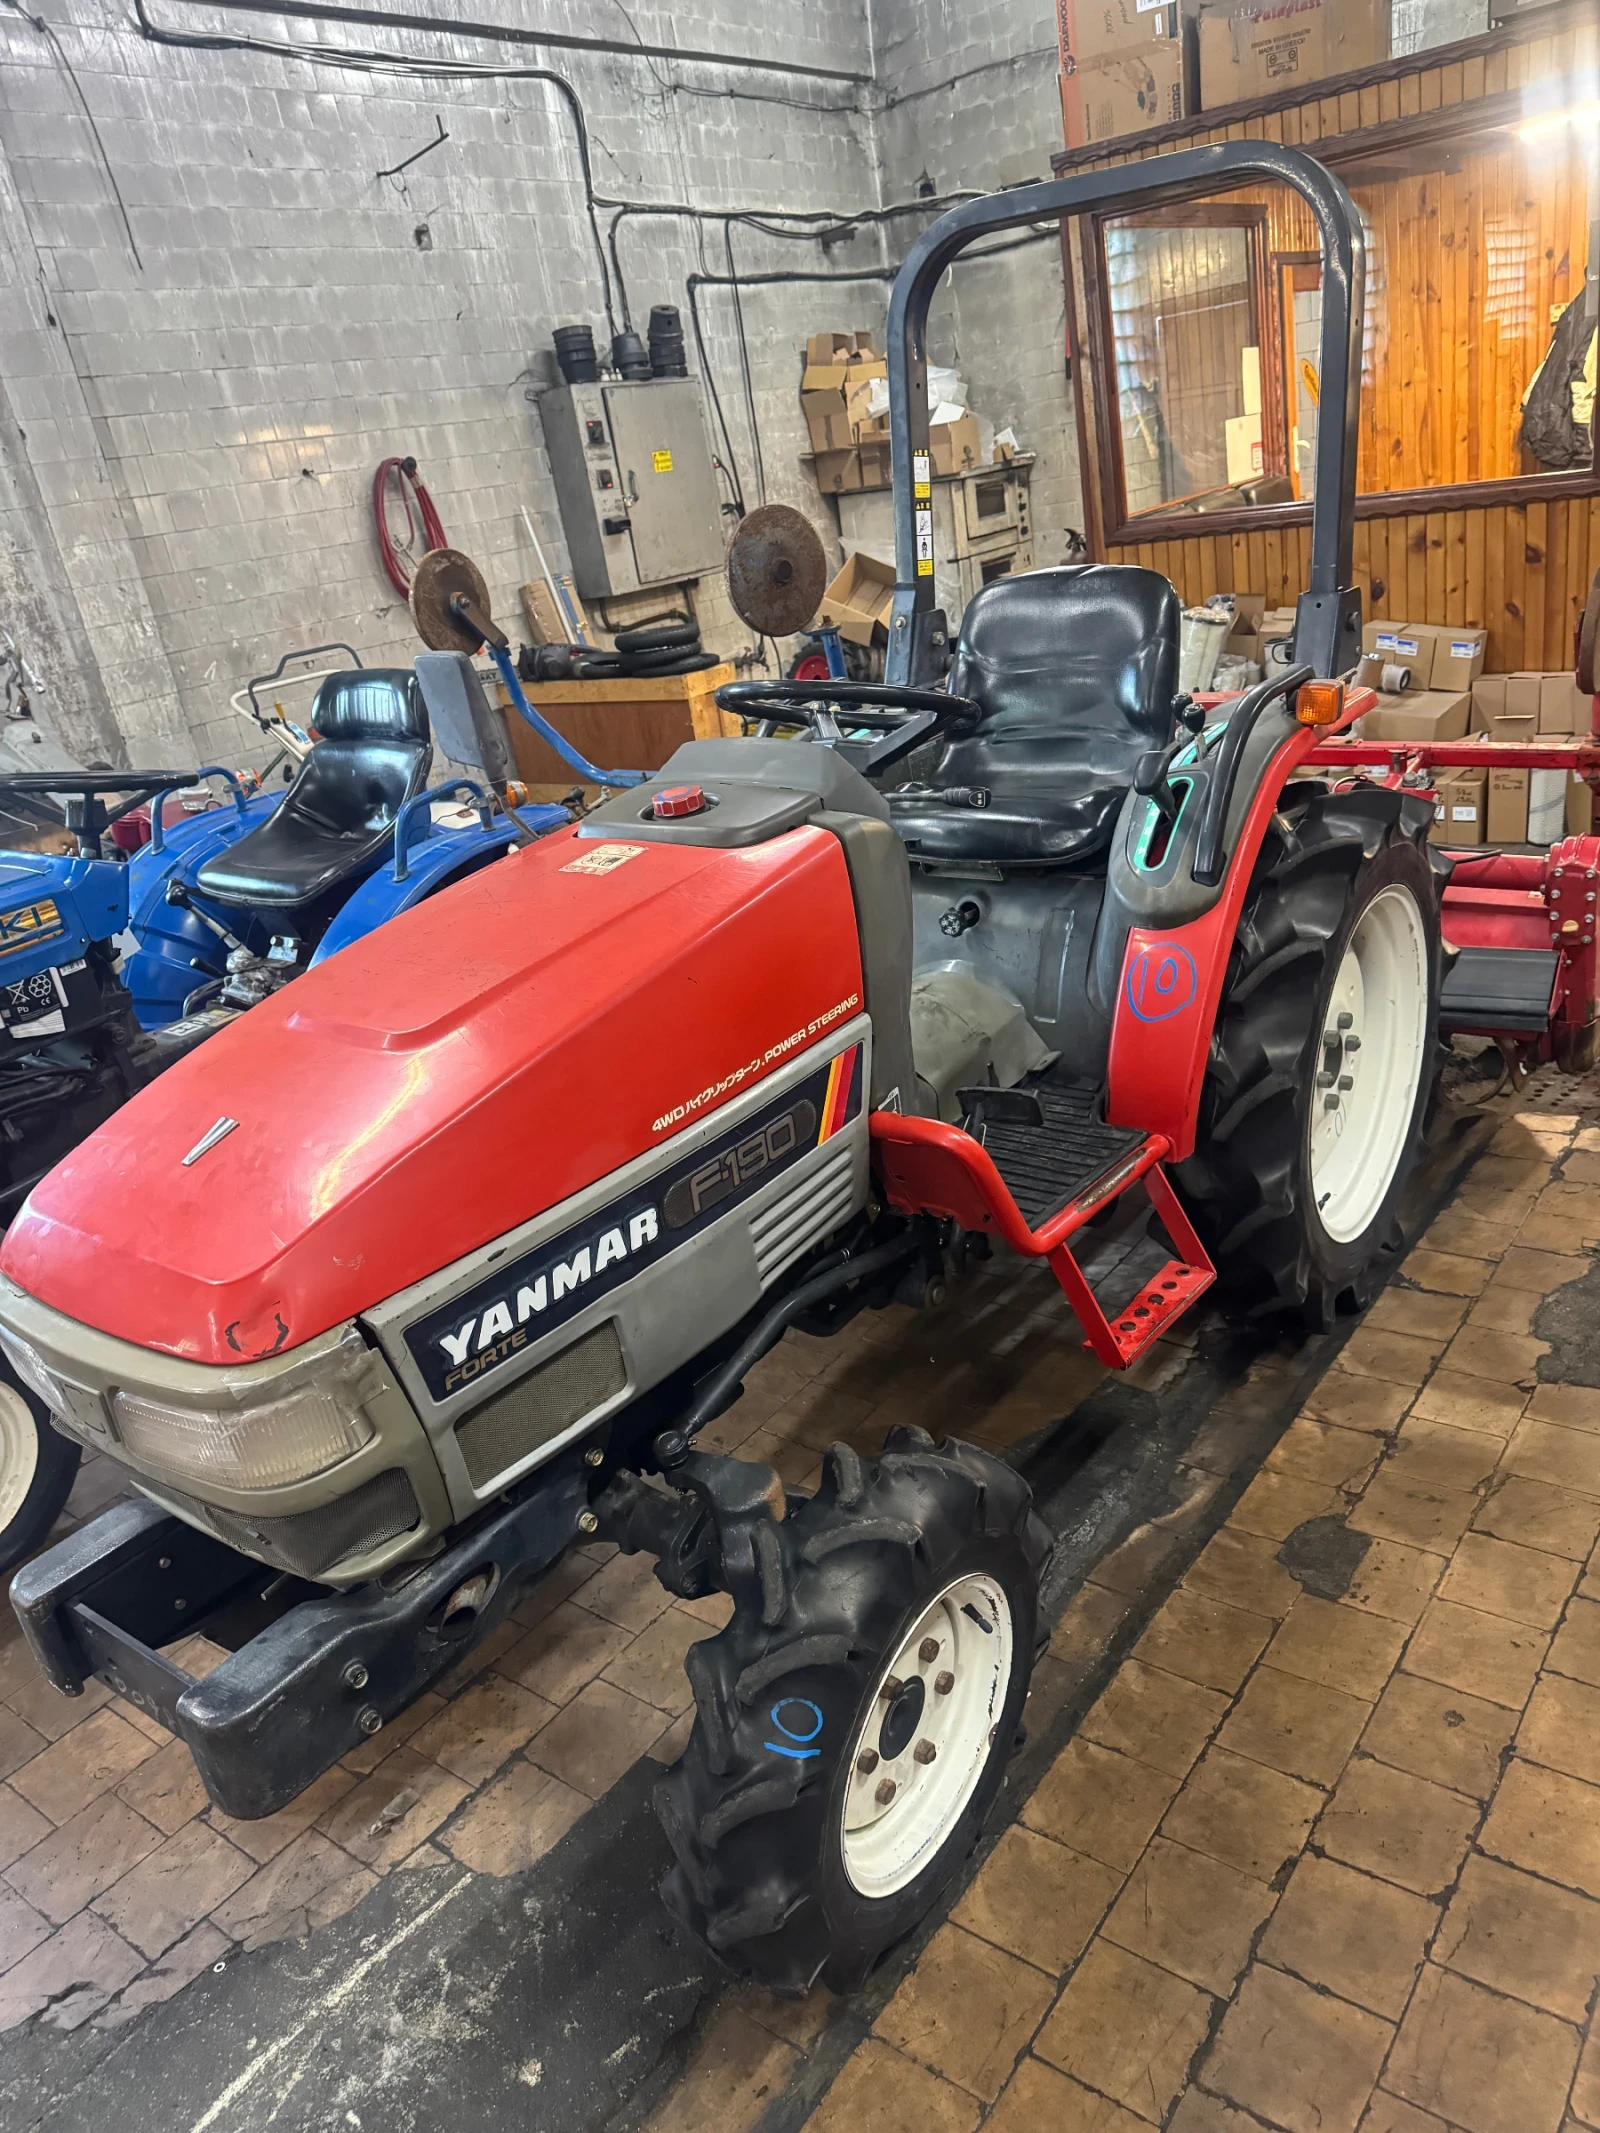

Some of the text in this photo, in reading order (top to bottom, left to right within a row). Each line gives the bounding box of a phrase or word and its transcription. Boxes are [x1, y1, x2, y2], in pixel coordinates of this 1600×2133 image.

[1258, 45, 1275, 55] MADE
[17, 1006, 29, 1014] Pb
[1138, 956, 1178, 1006] 10
[652, 1105, 685, 1132] 4WD
[764, 1028, 807, 1063] POWER
[808, 993, 859, 1035] STEERING
[439, 1206, 659, 1367] YANMAR
[445, 1328, 528, 1391] FORTE
[764, 1697, 824, 1759] 10
